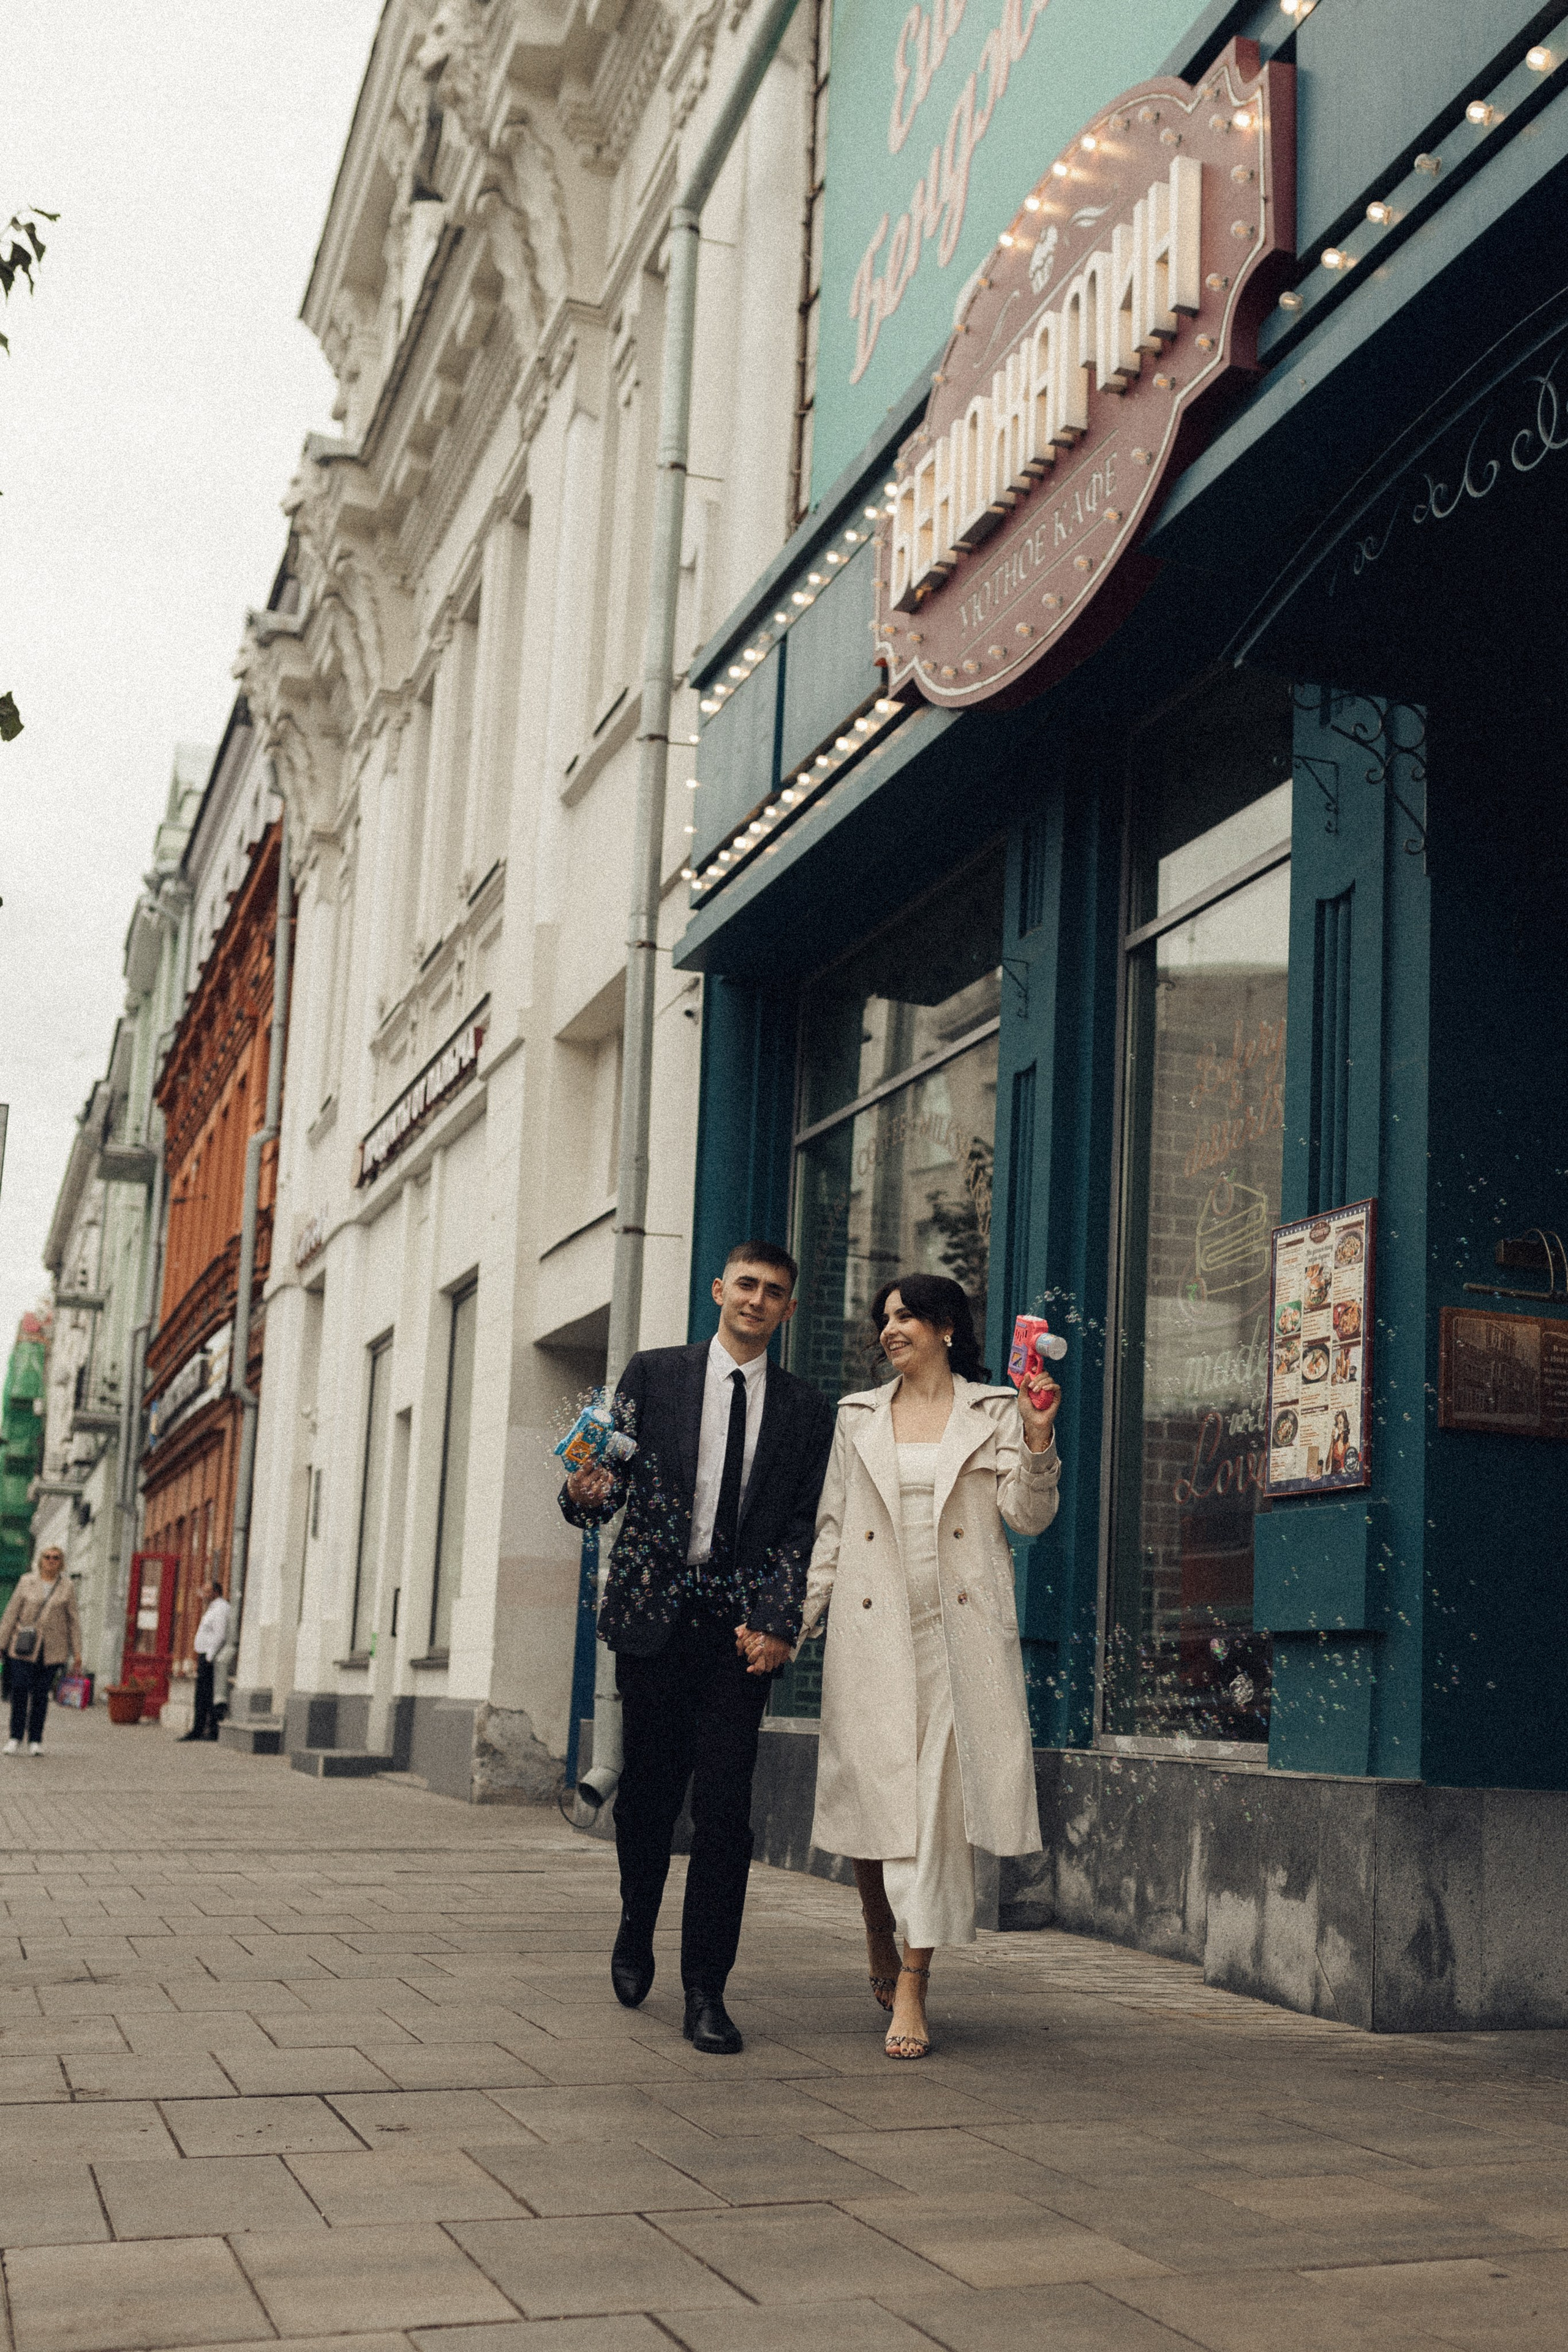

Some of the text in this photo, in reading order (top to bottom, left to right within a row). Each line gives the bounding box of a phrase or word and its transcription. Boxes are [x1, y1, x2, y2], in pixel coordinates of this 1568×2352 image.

[849, 0, 1046, 385] Бендж
[889, 156, 1202, 612] БЕНДЖАМИН
[957, 451, 1118, 638] УЮТНОЕ КАФЕ
